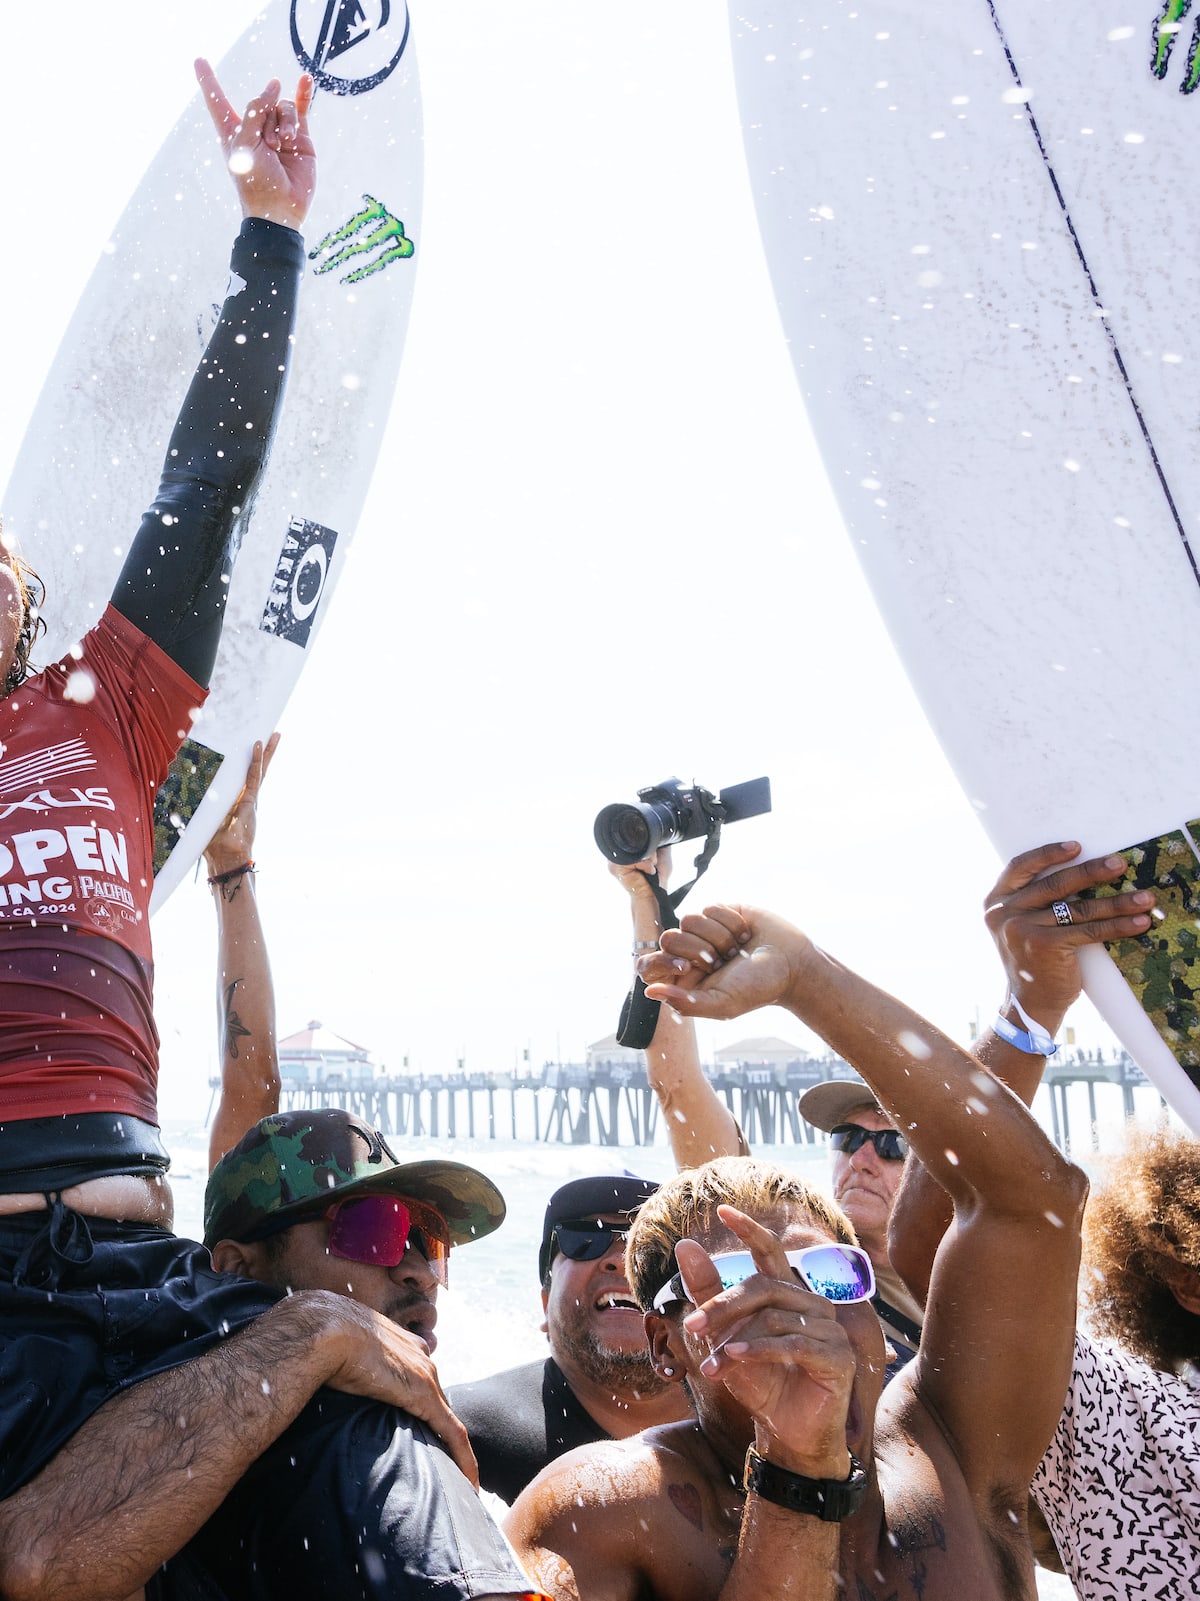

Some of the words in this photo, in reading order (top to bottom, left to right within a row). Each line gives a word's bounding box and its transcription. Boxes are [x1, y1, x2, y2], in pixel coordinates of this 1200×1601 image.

[12, 907, 35, 917] CA
[38, 903, 77, 915] 2024
[746, 1070, 771, 1084] YETI
